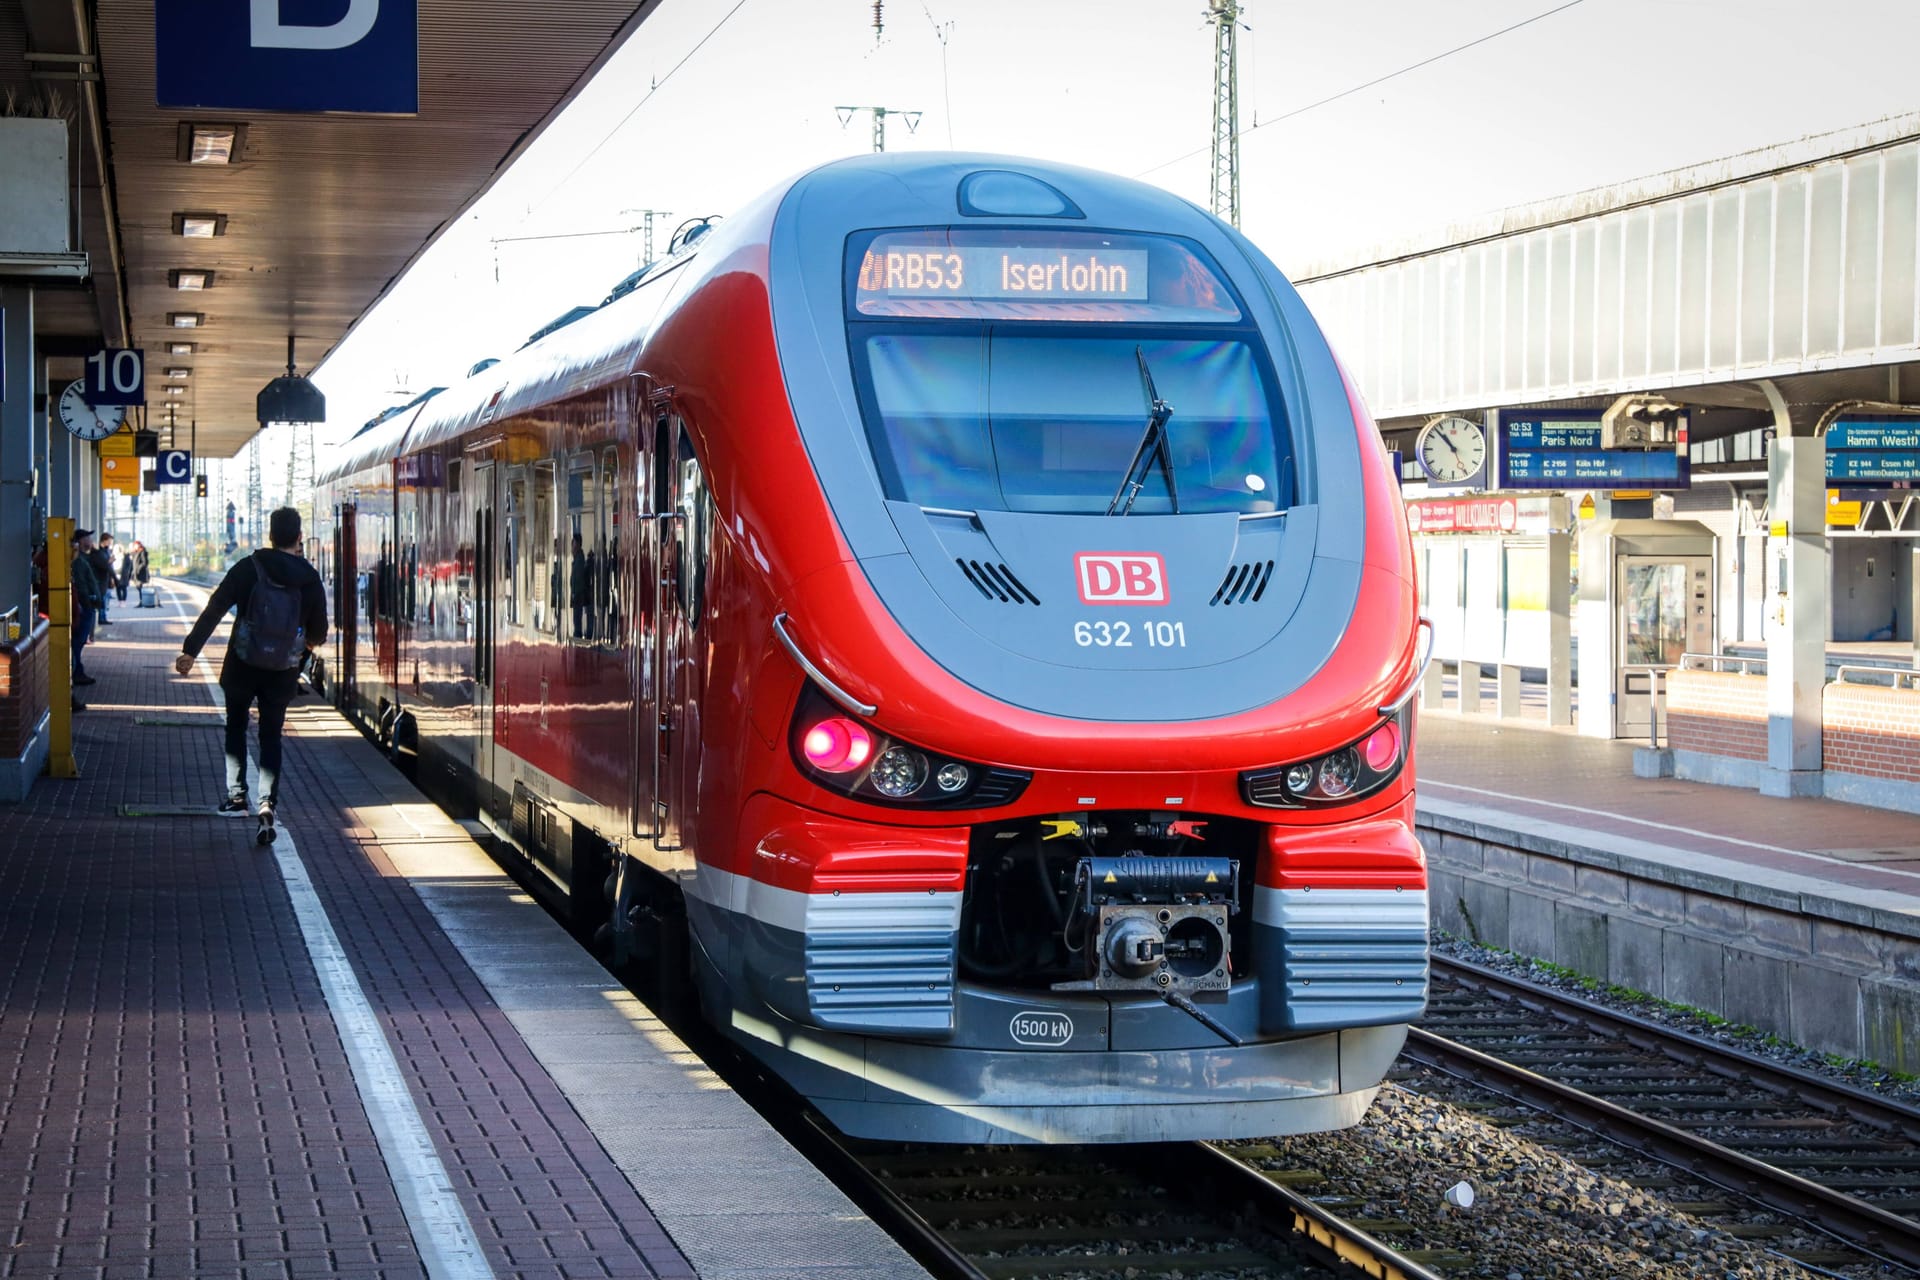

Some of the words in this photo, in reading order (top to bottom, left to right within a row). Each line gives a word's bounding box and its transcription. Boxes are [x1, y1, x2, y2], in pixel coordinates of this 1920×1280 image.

[887, 253, 963, 290] RB53
[1002, 255, 1127, 292] Iserlohn
[87, 350, 142, 393] 10
[1510, 423, 1531, 432] 10:53
[1541, 436, 1566, 446] Paris
[1570, 436, 1593, 446] Nord
[1847, 436, 1878, 446] Hamm
[1881, 436, 1919, 446] (Westf)
[166, 451, 187, 478] C
[1881, 469, 1910, 478] Duisburg
[1456, 504, 1499, 528] WILLKOMMEN
[1085, 559, 1157, 597] DB
[1074, 620, 1133, 647] 632
[1143, 621, 1186, 648] 101
[1014, 1020, 1048, 1037] 1500
[1051, 1021, 1069, 1038] kN
